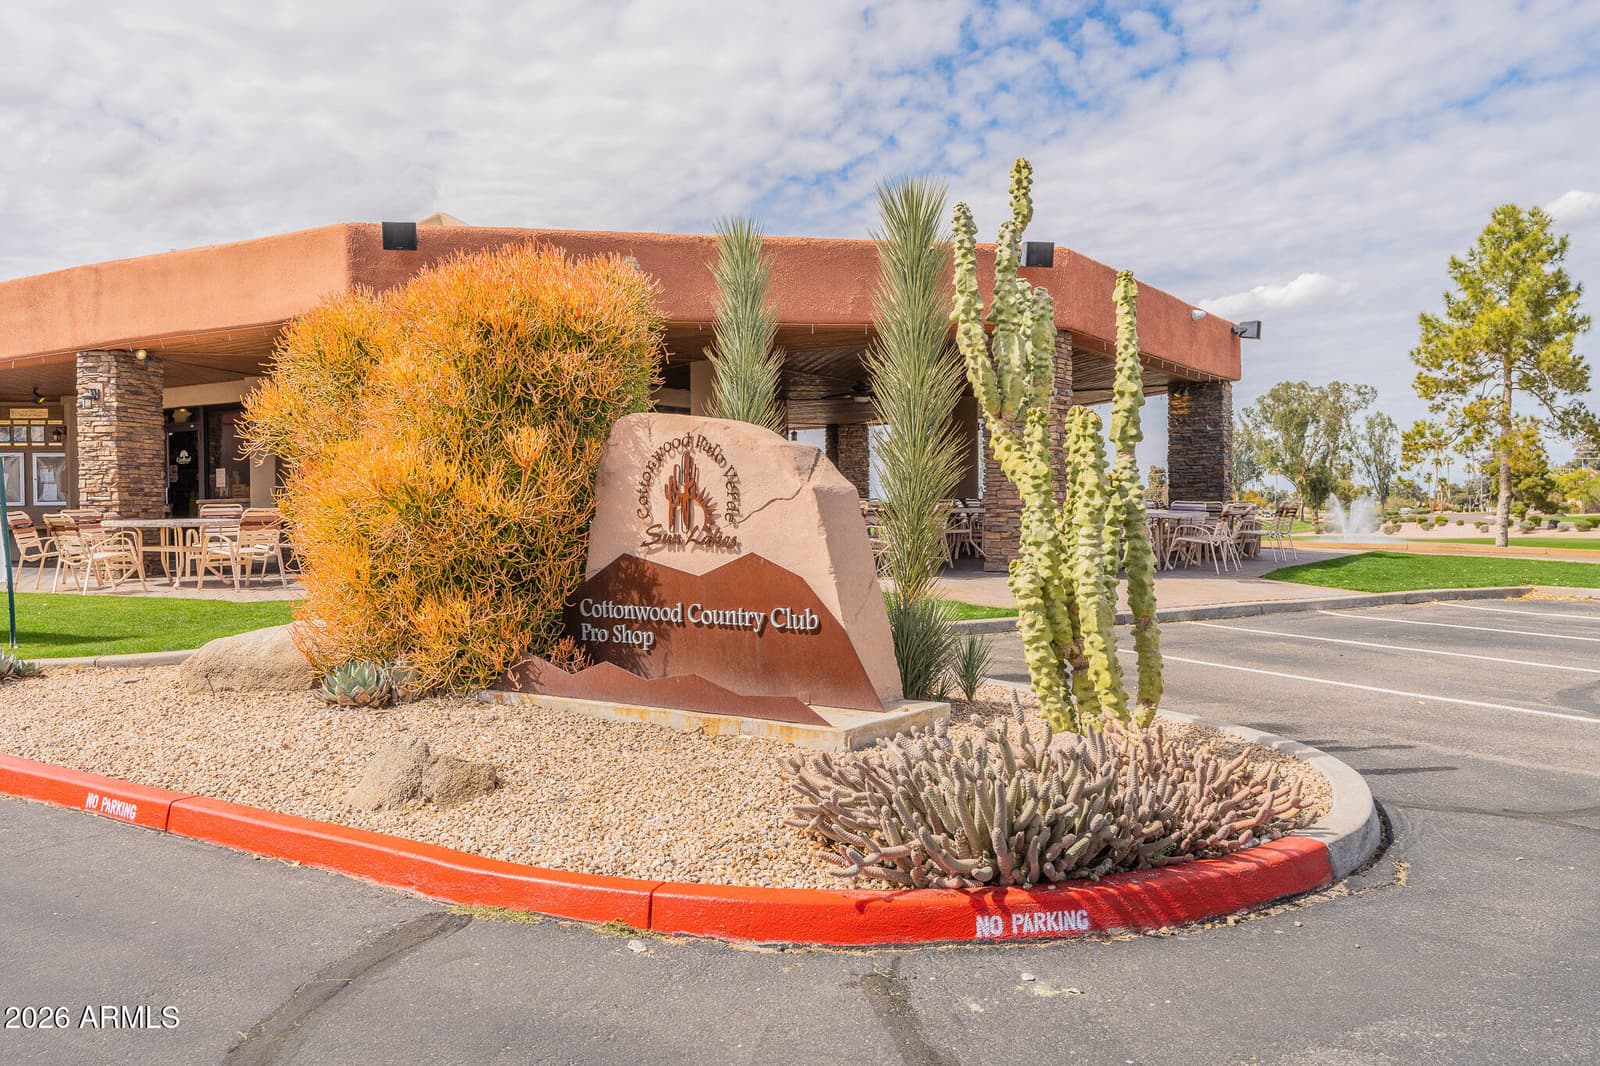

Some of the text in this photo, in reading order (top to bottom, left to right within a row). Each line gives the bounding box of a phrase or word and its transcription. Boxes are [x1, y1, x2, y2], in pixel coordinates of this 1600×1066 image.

[637, 432, 740, 524] Cottonwood Palo Verde
[640, 524, 738, 548] Sun Lakes
[579, 598, 820, 633] Cottonwood Country Club
[581, 623, 655, 650] Pro Shop
[85, 792, 137, 820] NO PARKING
[976, 909, 1089, 938] NO PARKING
